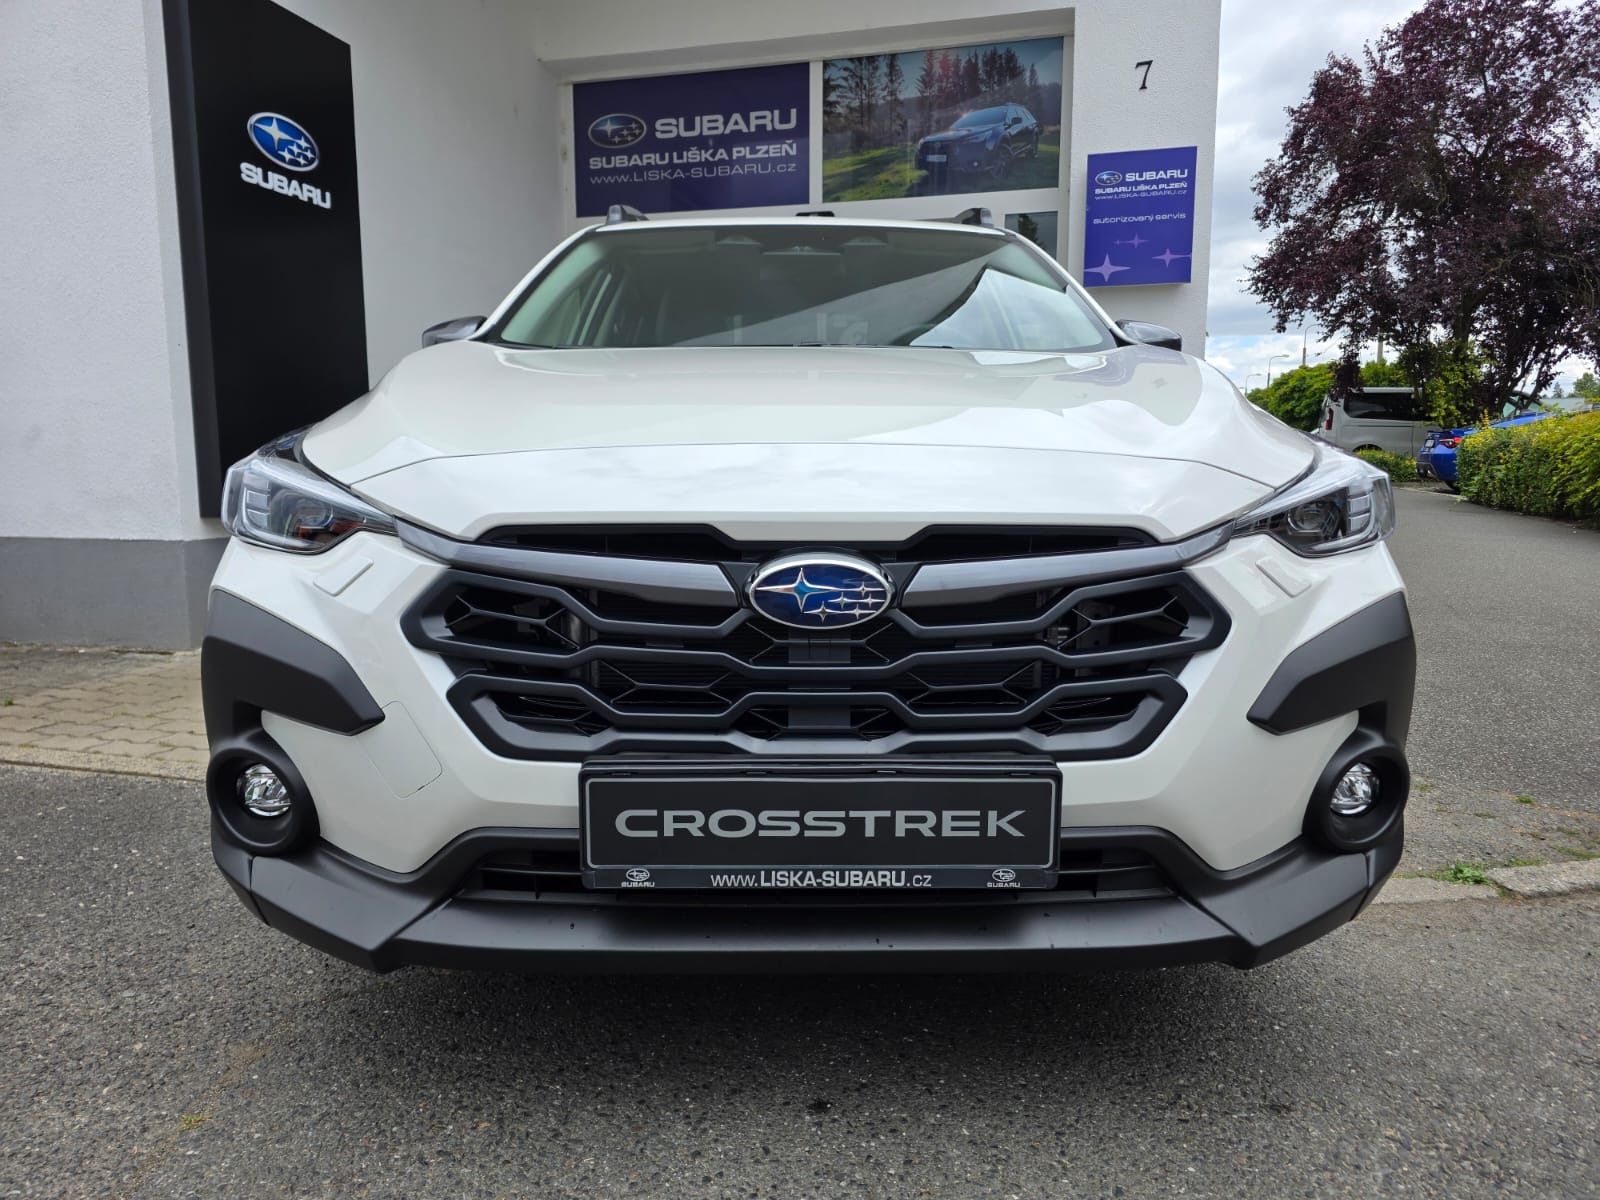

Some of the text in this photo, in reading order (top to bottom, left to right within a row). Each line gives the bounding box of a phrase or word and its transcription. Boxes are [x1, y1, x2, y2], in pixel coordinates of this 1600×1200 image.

[1134, 60, 1153, 90] 7
[655, 108, 797, 139] SUBARU
[589, 140, 797, 170] SUBARU LIŠKA PLZEŇ
[590, 162, 797, 185] www.LISKA-SUBARU.cz
[1125, 169, 1188, 182] SUBARU
[240, 162, 332, 209] SUBARU
[1094, 189, 1187, 201] www.LISKA-SUBARU.cz
[1095, 180, 1188, 195] SUBARU LIŠKA PLZEŇ
[1093, 211, 1186, 225] autorizovaný servis
[615, 809, 1026, 838] CROSSTREK
[710, 870, 932, 888] www.LISKA-SUBARU.cz
